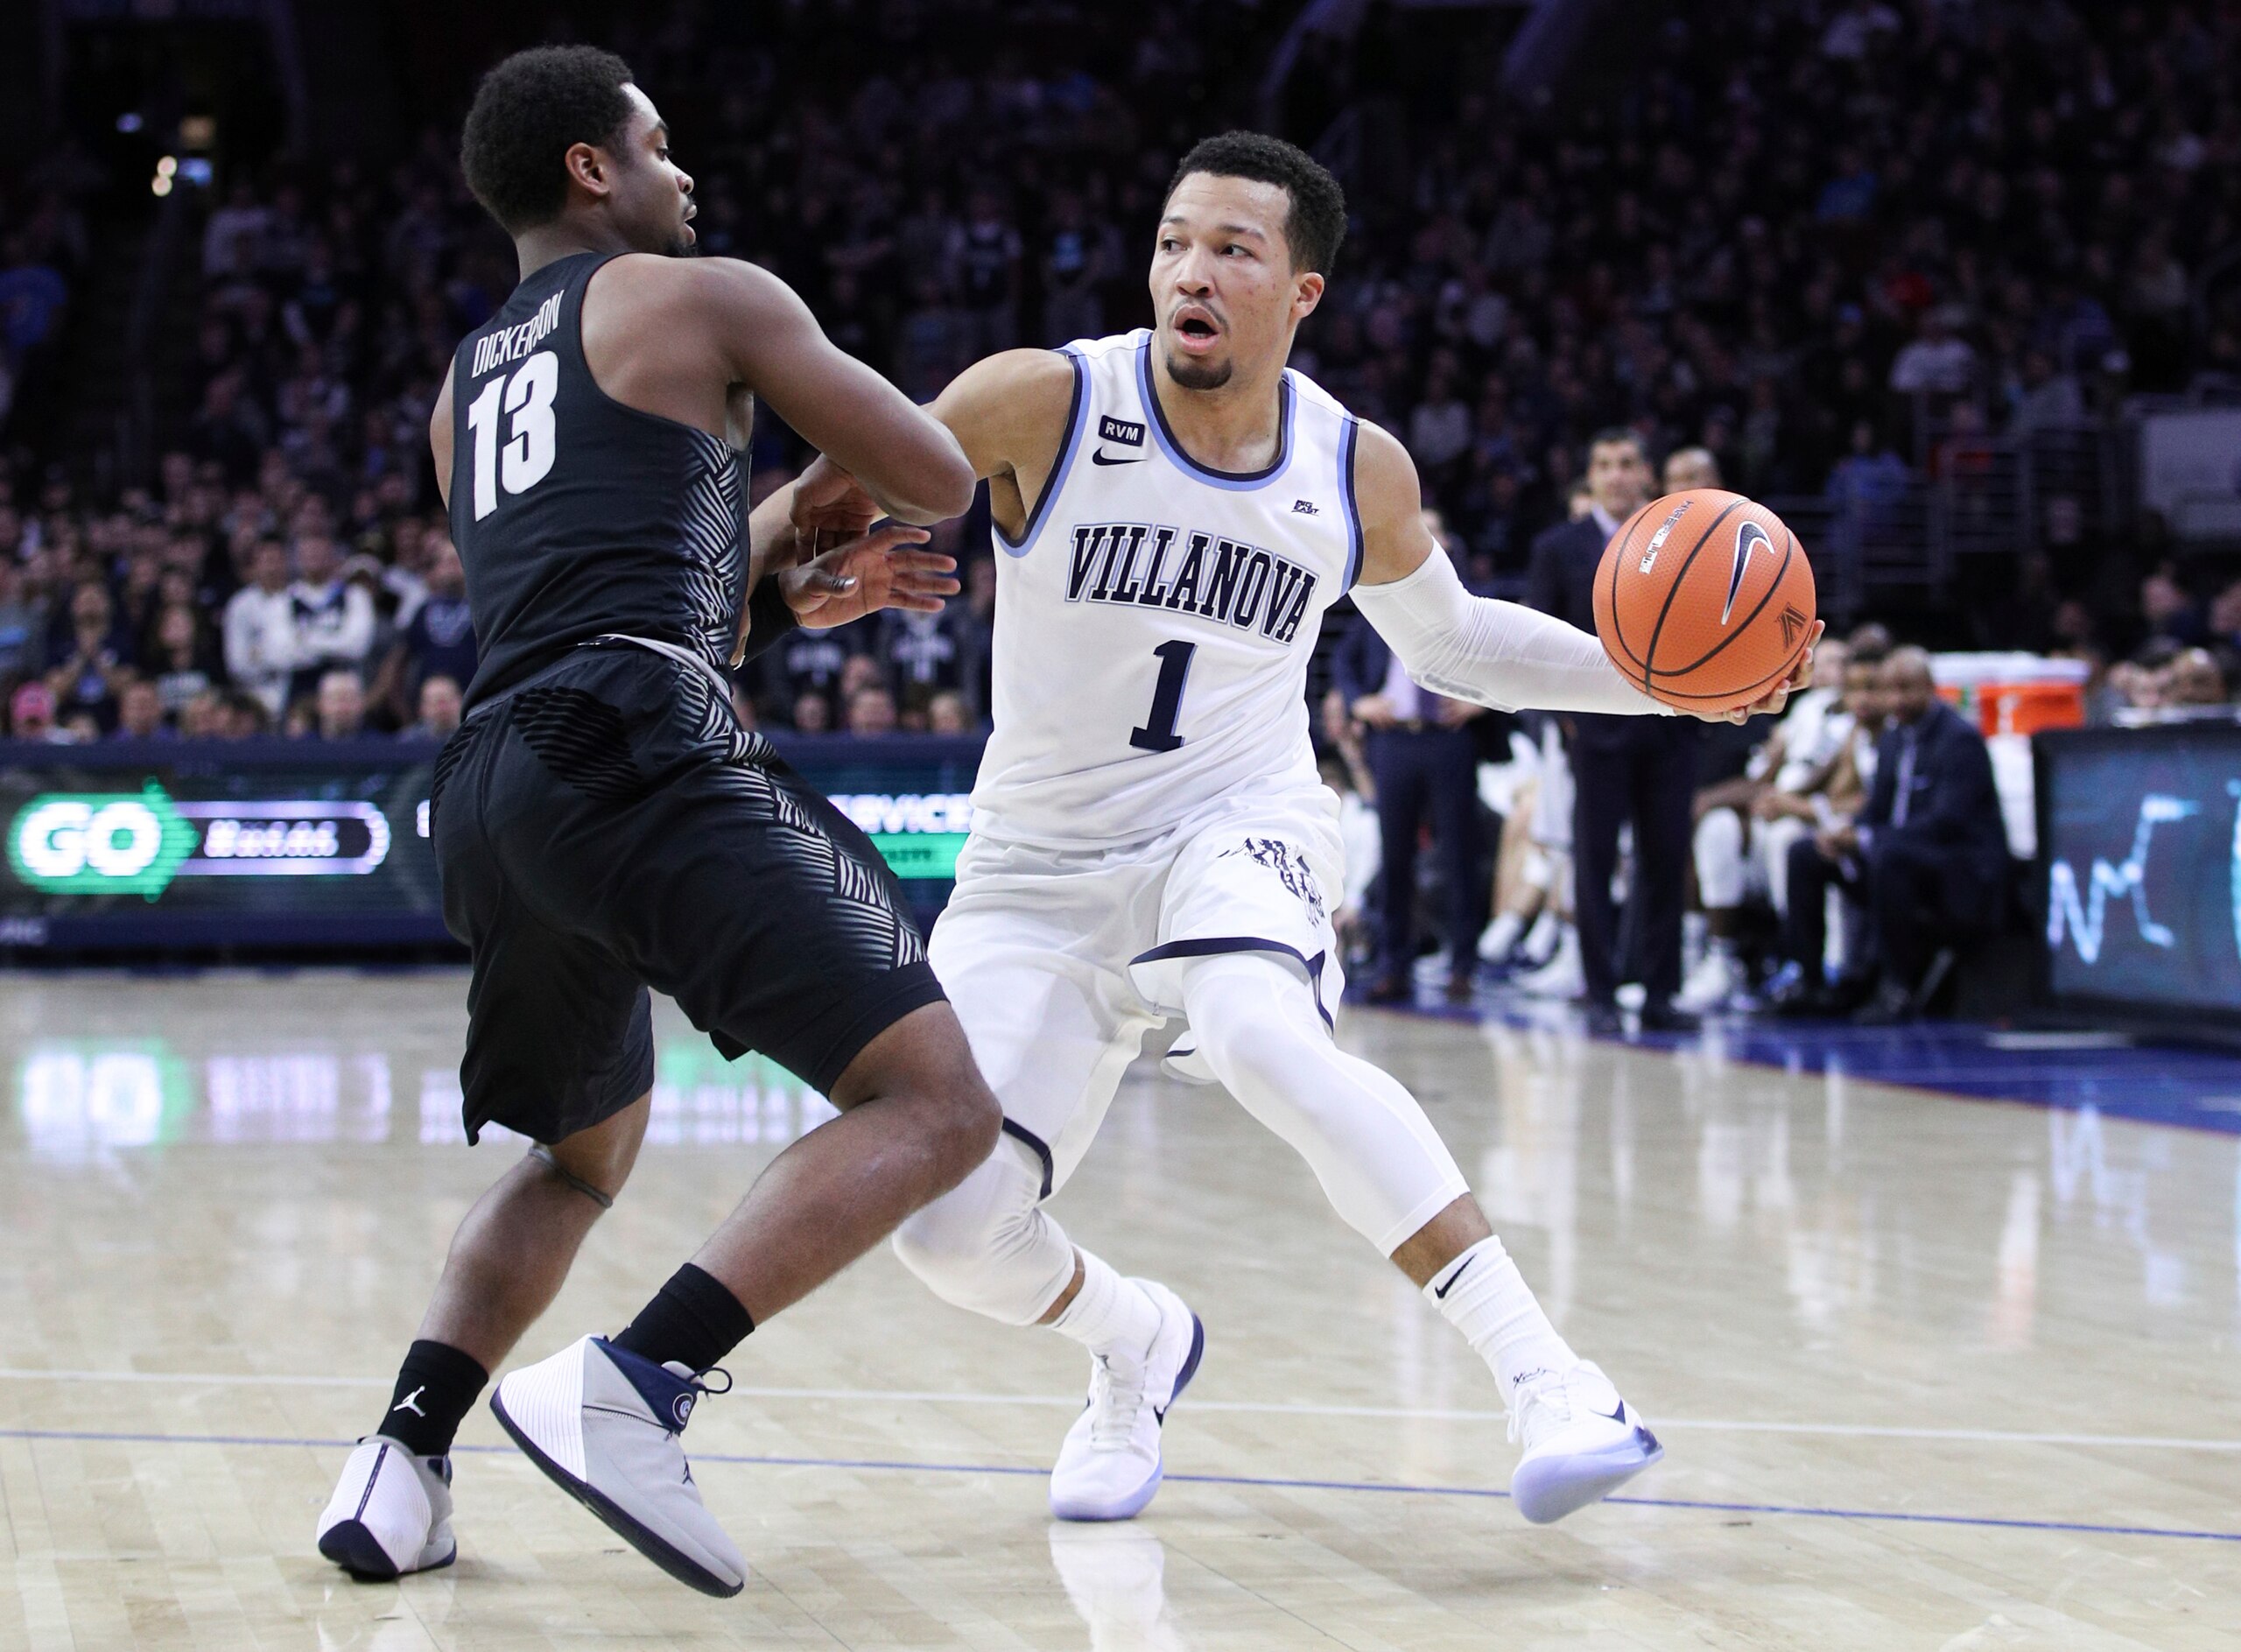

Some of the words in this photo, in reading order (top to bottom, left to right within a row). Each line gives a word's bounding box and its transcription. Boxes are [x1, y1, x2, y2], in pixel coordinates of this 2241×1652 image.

[468, 350, 558, 523] 13
[1105, 421, 1139, 441] RVM
[1065, 523, 1320, 646] VILLANOVA
[1129, 640, 1198, 753] 1
[19, 801, 163, 877] GO
